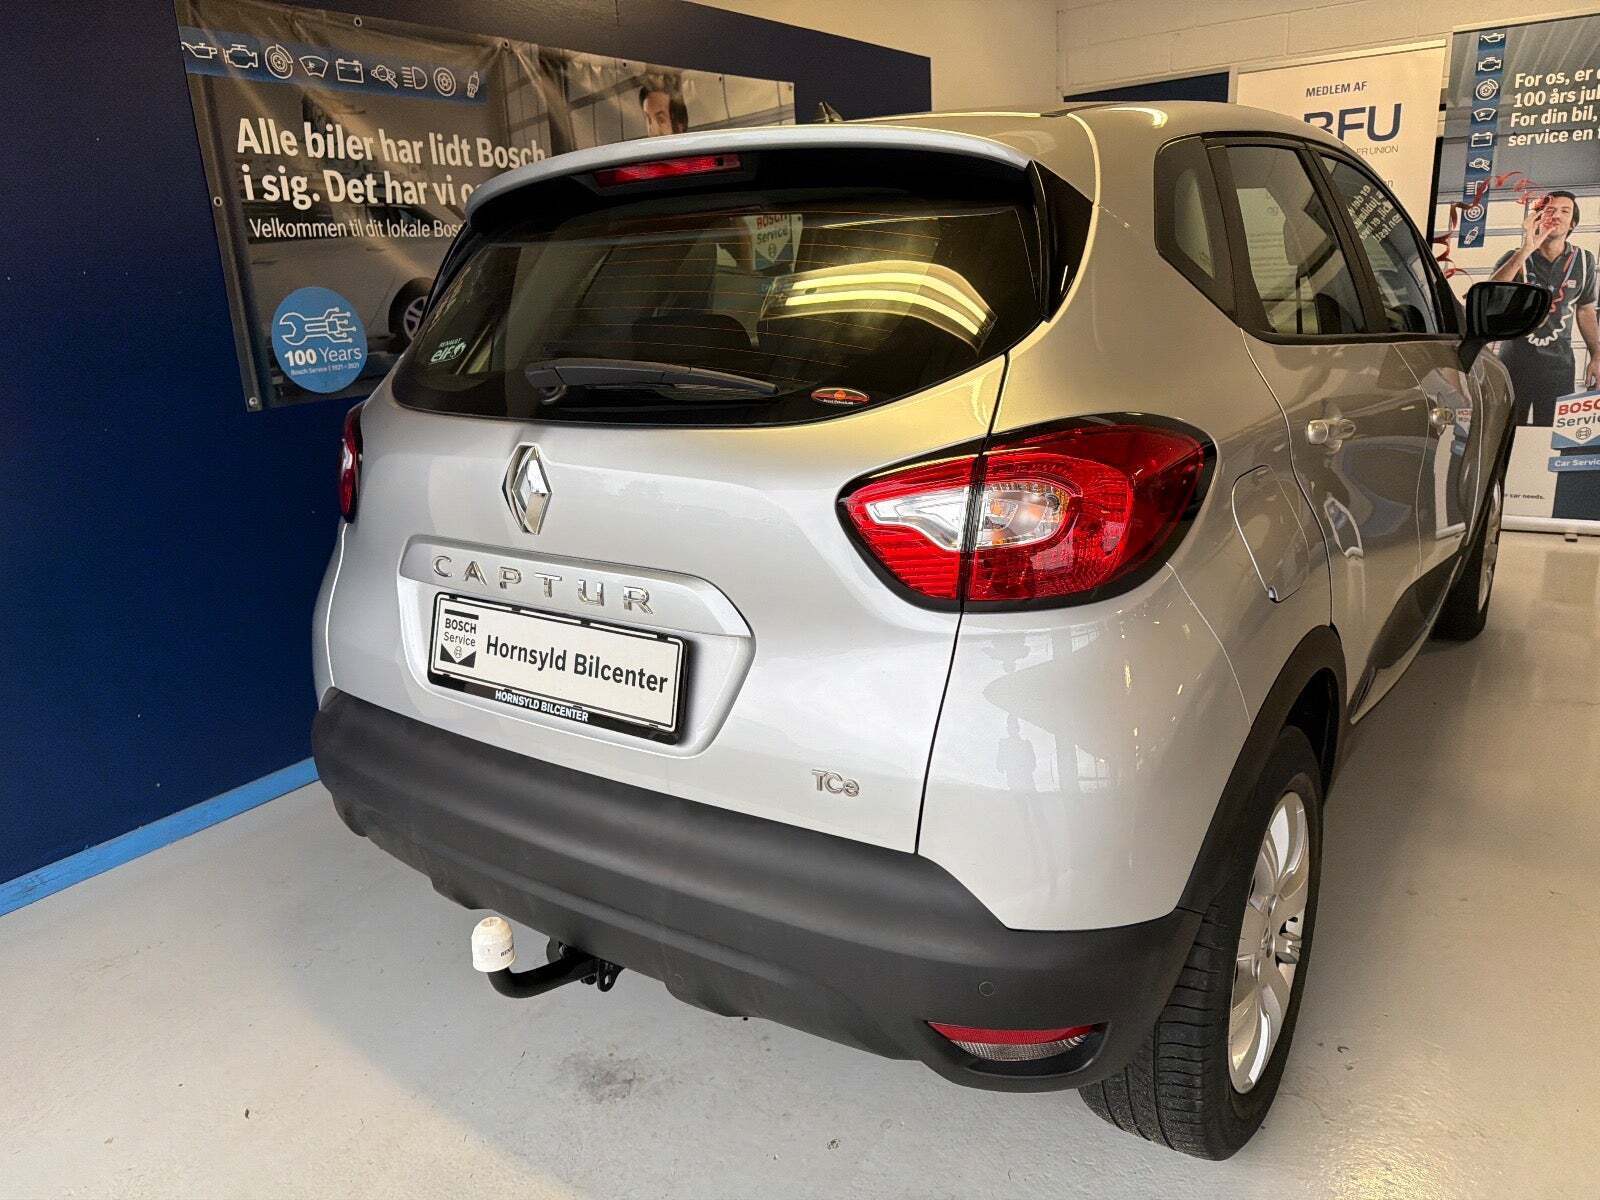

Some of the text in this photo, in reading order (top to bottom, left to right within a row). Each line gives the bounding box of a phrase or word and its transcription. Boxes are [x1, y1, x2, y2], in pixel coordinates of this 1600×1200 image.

[1515, 73, 1543, 88] For
[1546, 72, 1570, 85] os,
[1575, 69, 1594, 81] er
[1306, 81, 1368, 98] MEDLEM AF
[1513, 91, 1546, 107] 100
[1549, 88, 1576, 104] års
[1510, 105, 1598, 127] For din bil,
[237, 117, 546, 169] Alle biler har lidt Bosch
[1508, 129, 1569, 147] service
[1572, 128, 1593, 141] en
[1369, 145, 1399, 155] UNION
[241, 163, 255, 201] i
[262, 165, 321, 211] sig.
[323, 169, 378, 204] Det
[384, 170, 428, 205] har
[432, 174, 457, 205] vi
[249, 217, 347, 238] Velkommen
[349, 219, 364, 237] til
[366, 218, 385, 237] dit
[386, 218, 430, 238] lokale
[284, 347, 362, 366] 100 Years
[432, 555, 654, 616] CAPTUR
[444, 617, 477, 634] BOSCH
[444, 631, 476, 647] Service
[486, 634, 669, 693] Hornsyld Bilcenter
[495, 689, 589, 723] HORNSYLD BILCENTER
[812, 769, 859, 797] TCe
